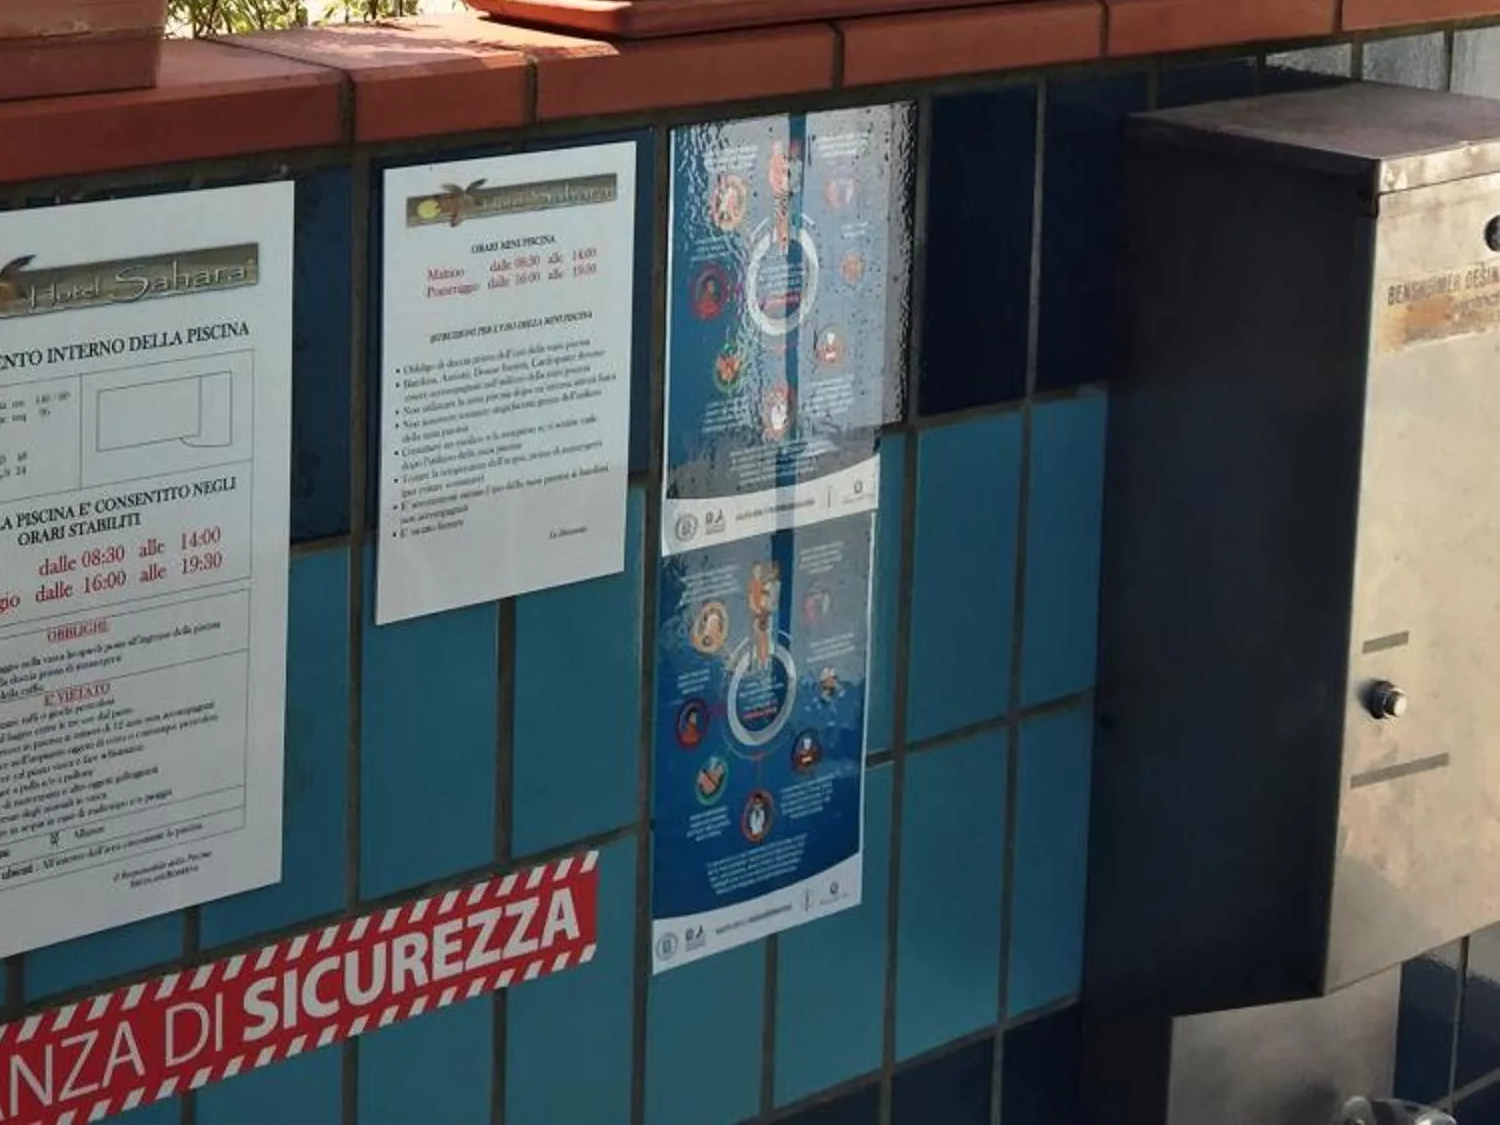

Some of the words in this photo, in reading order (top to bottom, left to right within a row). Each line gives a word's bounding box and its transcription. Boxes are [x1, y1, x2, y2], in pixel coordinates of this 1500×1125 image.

[29, 276, 101, 309] Hotel
[114, 251, 246, 302] Sahara
[47, 337, 125, 364] INTERNO
[128, 329, 183, 353] DELLA
[186, 320, 250, 345] PISCINA
[16, 503, 74, 528] PISCINA
[94, 483, 190, 514] CONSENTITO
[193, 475, 236, 497] NEGLI
[17, 524, 64, 547] ORARI
[67, 510, 142, 538] STABILITI
[37, 551, 77, 578] dalle
[80, 543, 125, 570] 08:30
[138, 535, 164, 559] alle
[180, 525, 221, 551] 14:00
[35, 578, 72, 604] dalle
[83, 568, 127, 595] 16:00
[139, 560, 167, 584] alle
[181, 550, 222, 576] 19:30
[165, 992, 224, 1066] DI
[243, 887, 581, 1043] SICUREZZA
